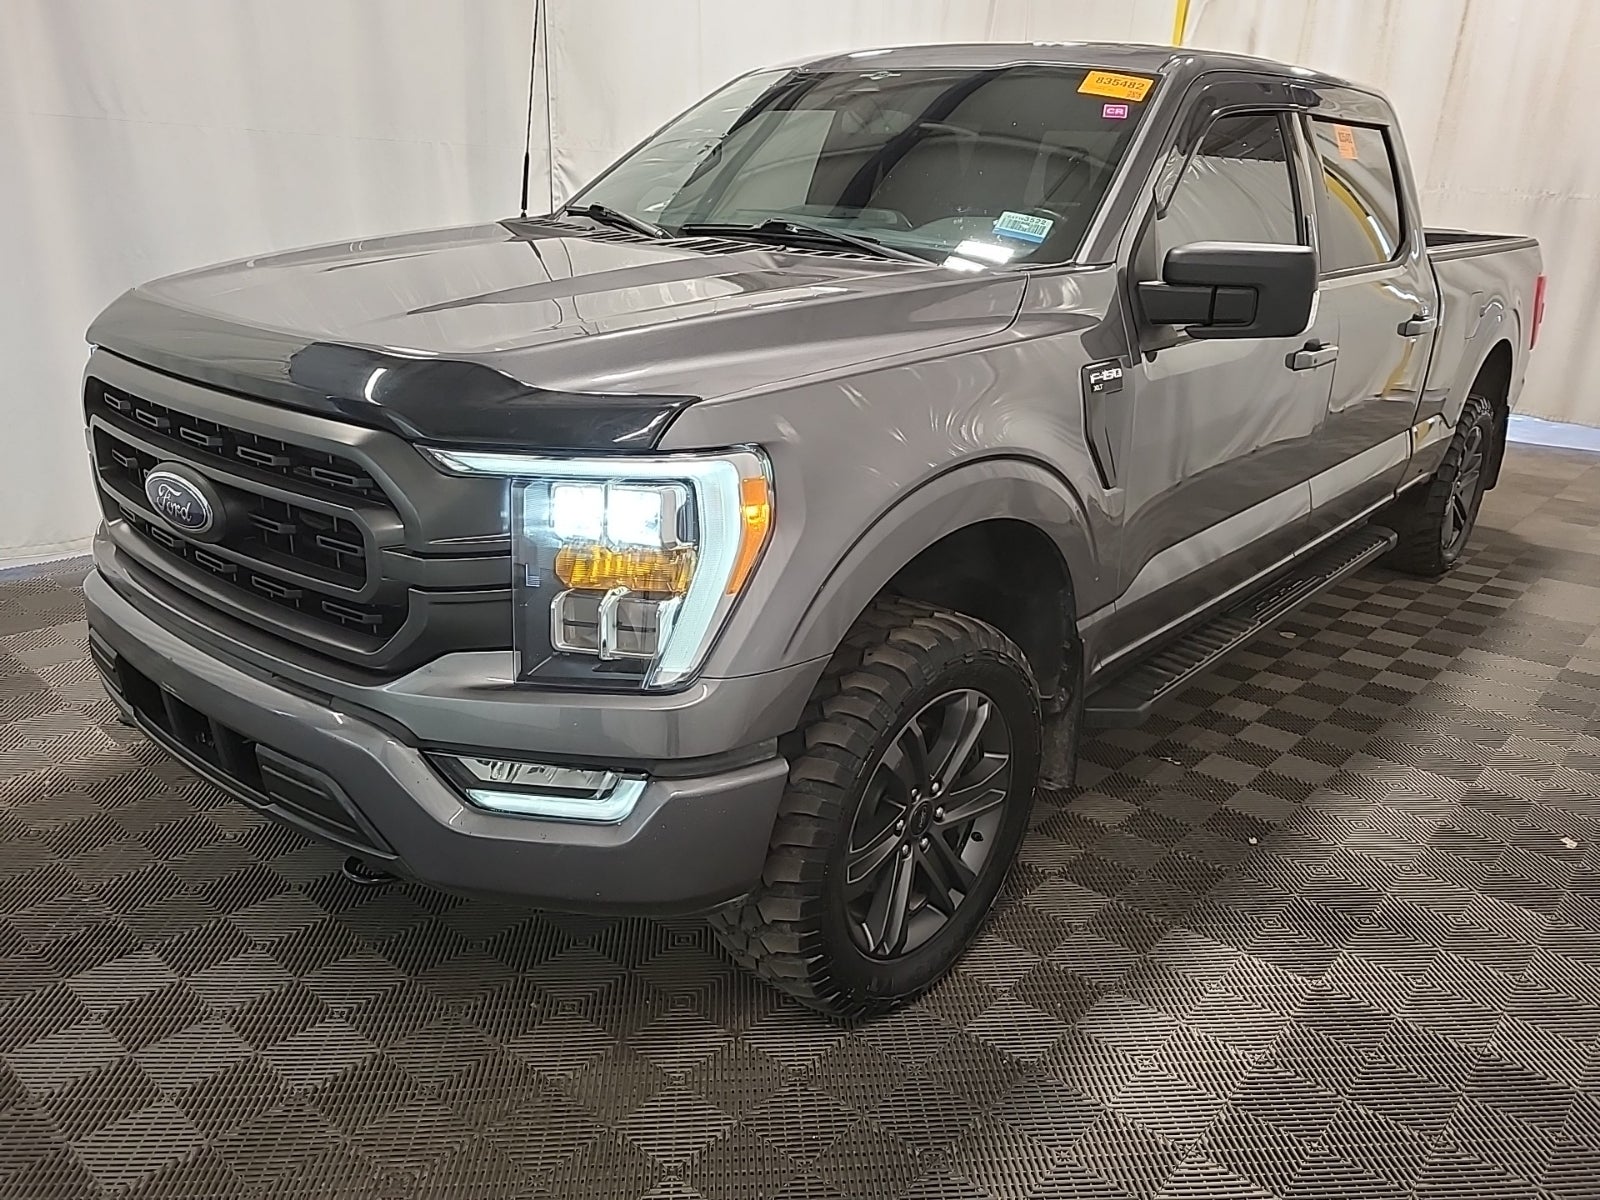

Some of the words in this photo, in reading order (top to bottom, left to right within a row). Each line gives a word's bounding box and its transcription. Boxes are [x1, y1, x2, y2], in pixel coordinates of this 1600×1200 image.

[1095, 77, 1145, 90] 835482
[1106, 107, 1124, 115] CR
[1090, 368, 1122, 384] F-150
[157, 484, 192, 522] Ford
